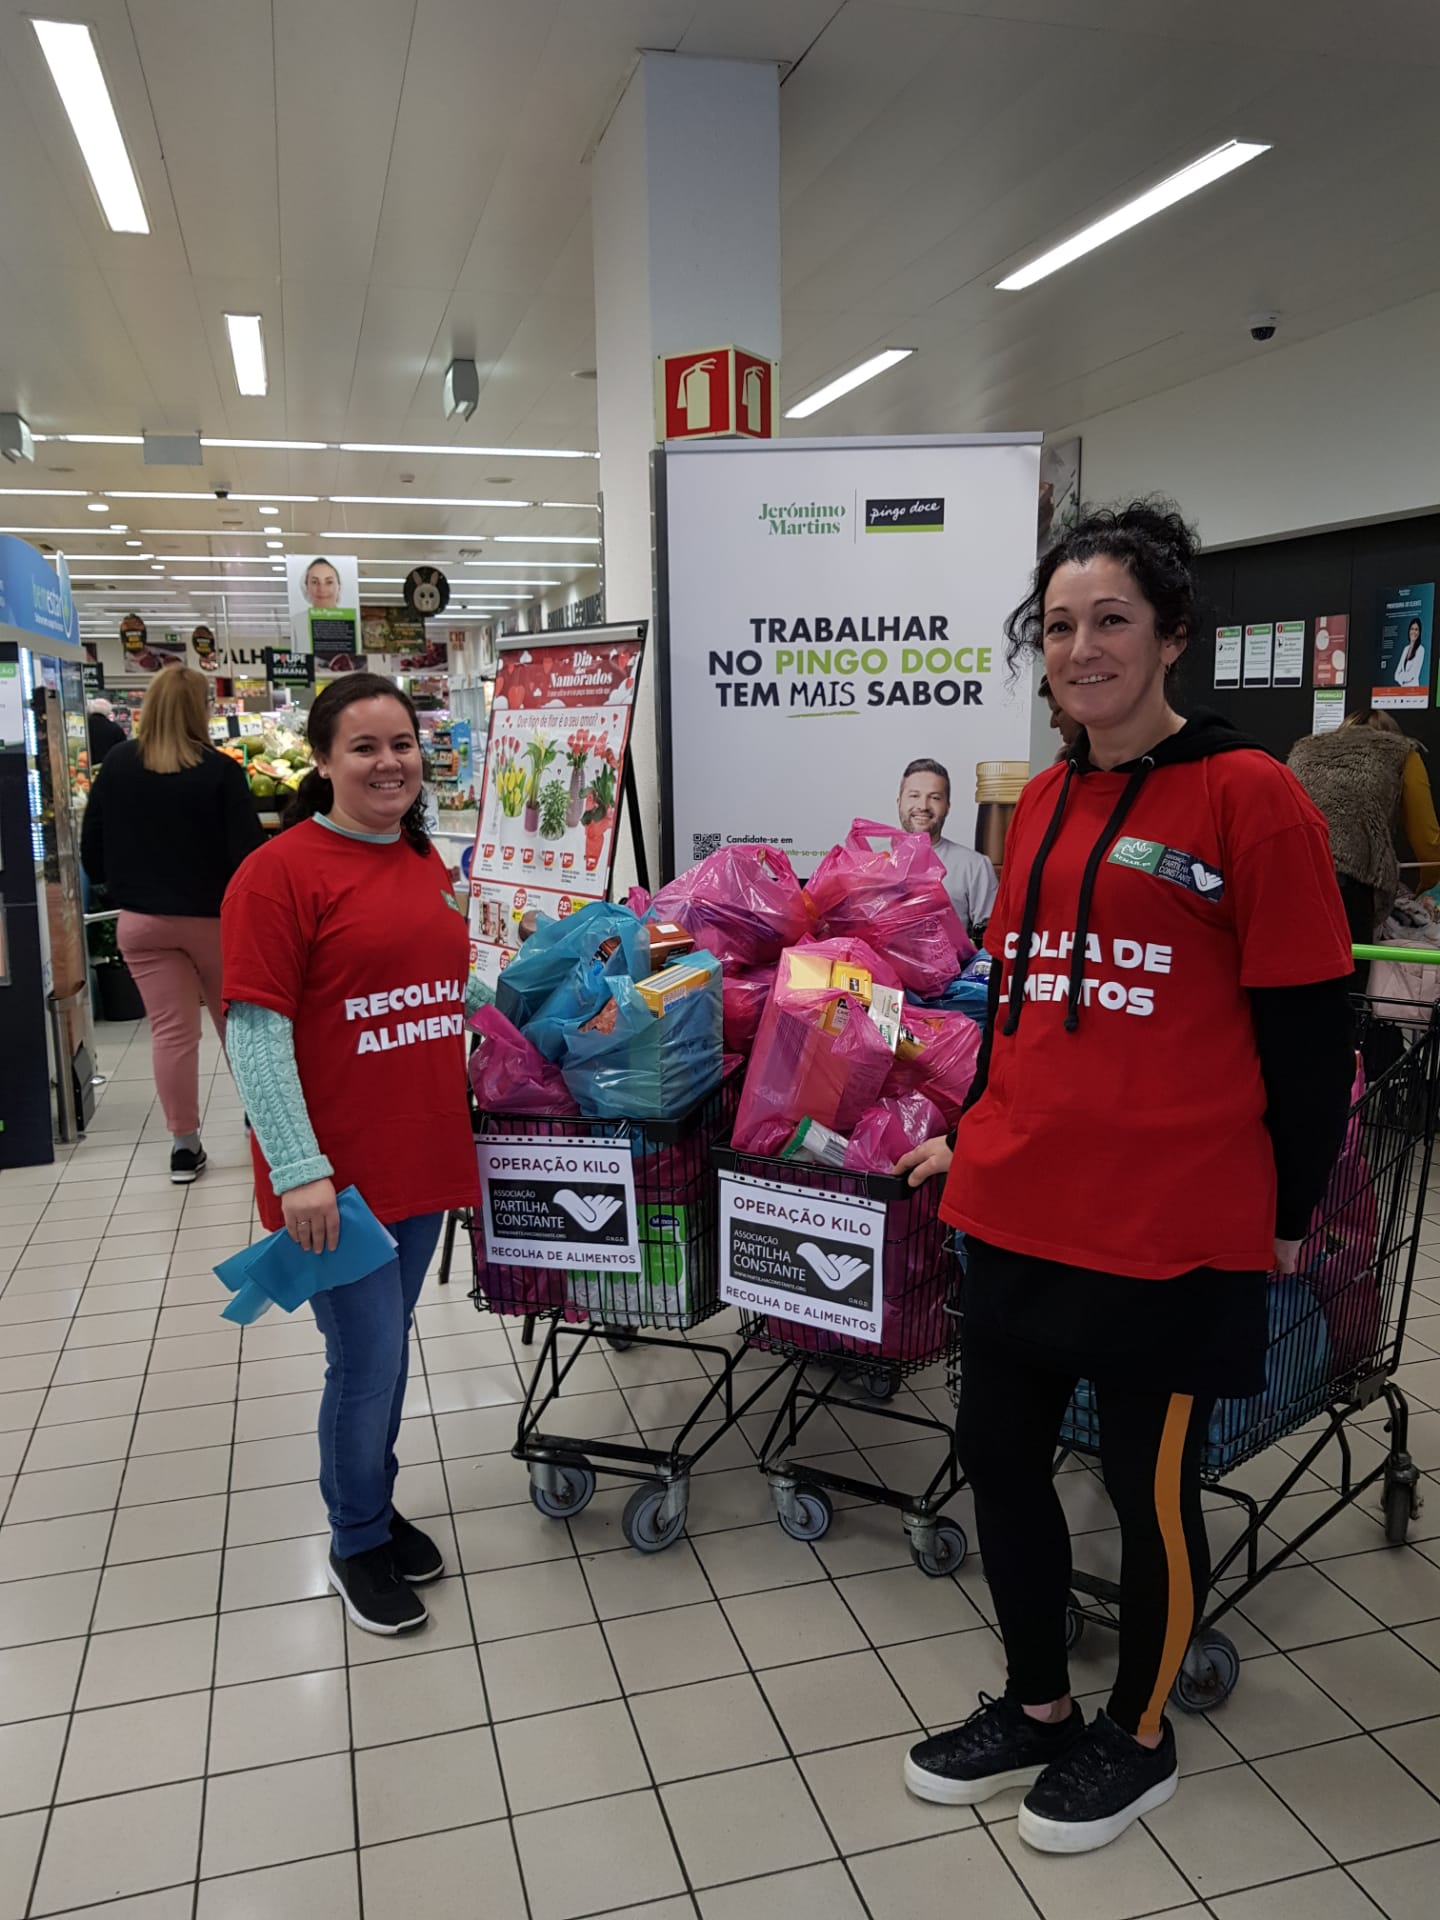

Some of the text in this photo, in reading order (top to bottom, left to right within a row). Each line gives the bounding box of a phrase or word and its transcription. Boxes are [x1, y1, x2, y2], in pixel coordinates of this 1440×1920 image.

[758, 502, 846, 520] Jerónimo
[870, 501, 941, 524] pingo doce
[768, 519, 841, 536] Martins
[750, 616, 949, 643] TRABALHAR
[573, 650, 592, 668] Dia
[709, 647, 992, 676] NO PINGO DOCE
[550, 669, 613, 688] Namorados
[716, 680, 983, 707] TEM MAIS SABOR
[726, 835, 778, 844] Candidate-se
[1113, 938, 1172, 974] DE
[357, 1014, 465, 1054] ALIMENT
[489, 1156, 620, 1174] OPERAÇÃO KILO
[493, 1189, 536, 1199] ASSOCIAÇÃO
[494, 1199, 549, 1214] PARTILHA
[733, 1196, 872, 1236] OPERAÇÃO KILO
[495, 1214, 565, 1229] CONSTANTE
[734, 1229, 779, 1245] ASSOCIAÇÃO
[491, 1246, 636, 1264] RECOLHA DE ALIMENTOS
[733, 1239, 792, 1263] PARTILHA
[733, 1254, 806, 1282] CONSTANTE
[726, 1285, 876, 1333] RECOLHA DE ALIMENTOS
